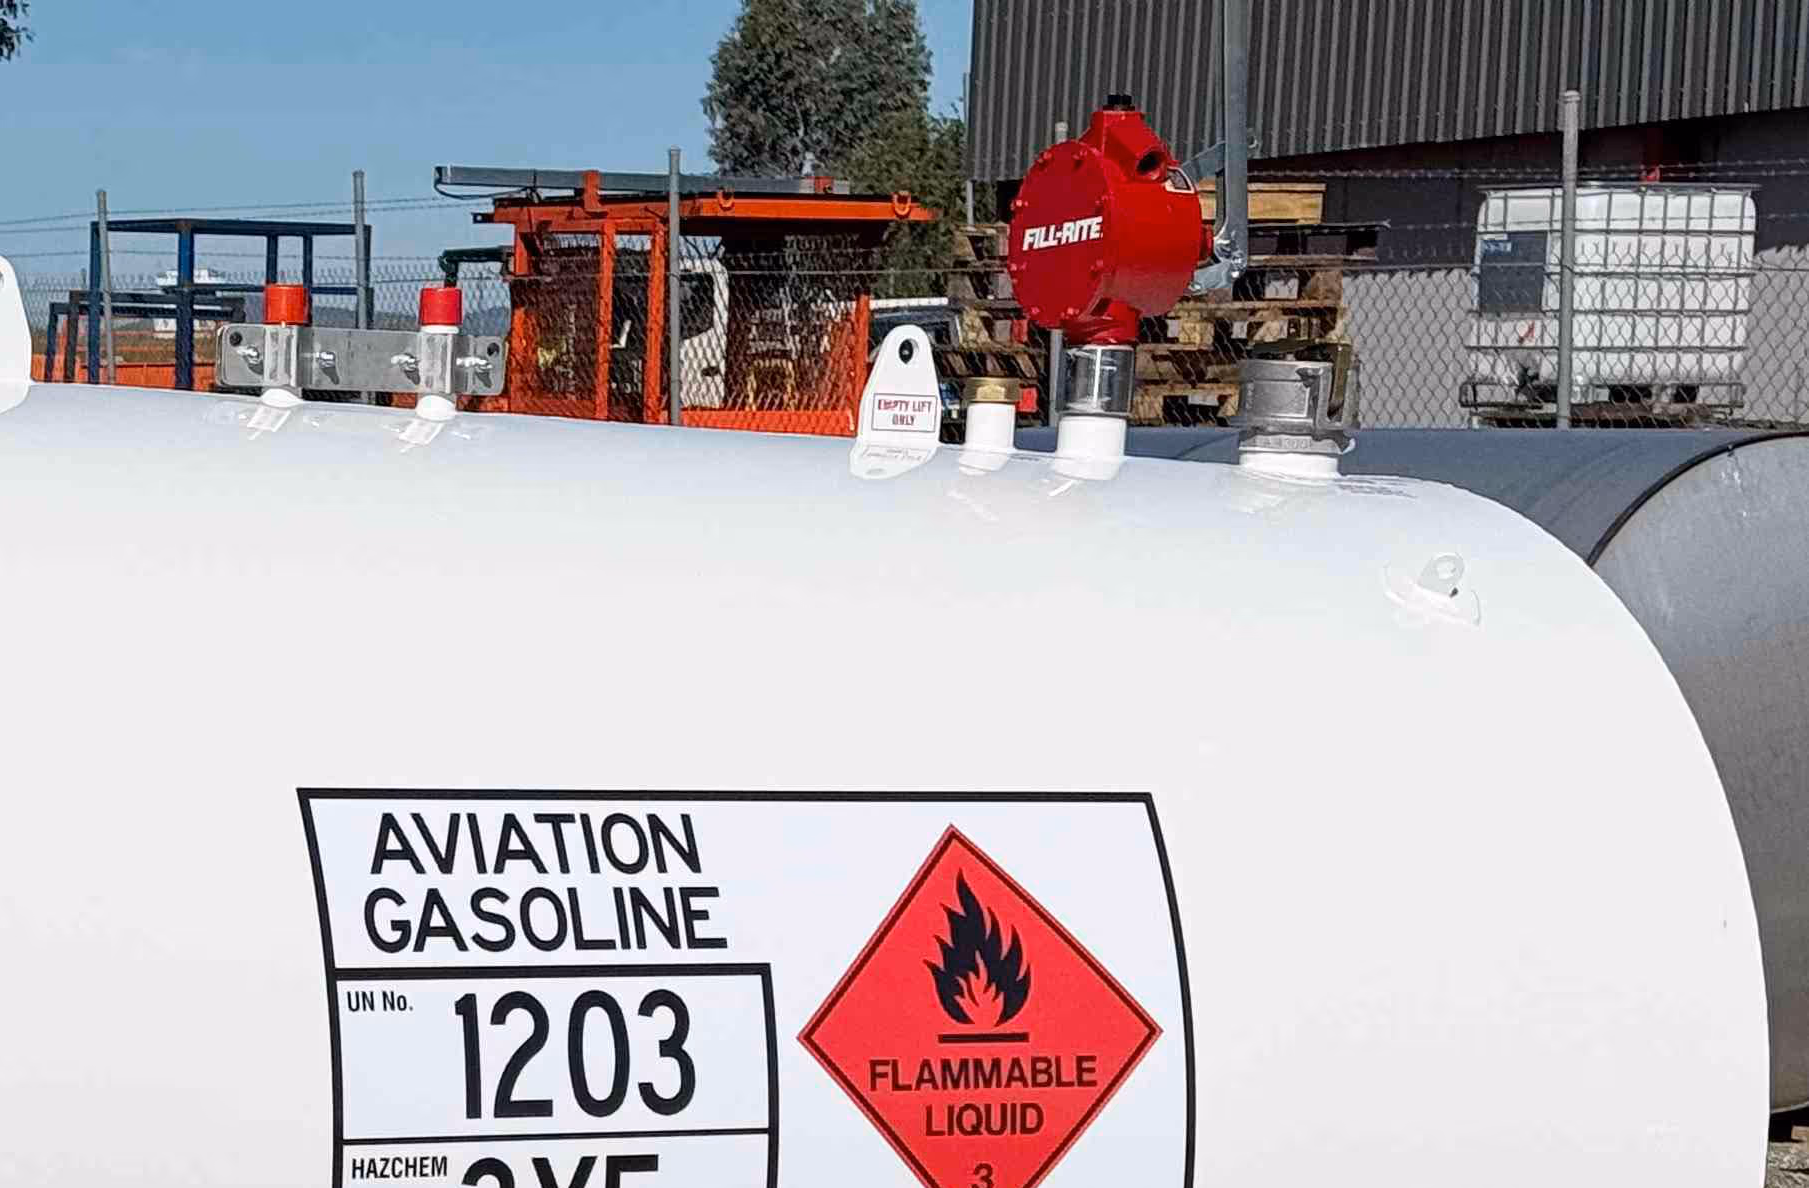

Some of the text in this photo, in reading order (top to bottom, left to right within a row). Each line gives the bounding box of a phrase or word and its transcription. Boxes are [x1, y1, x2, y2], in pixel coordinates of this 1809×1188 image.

[1022, 216, 1103, 251] FILL-RITE
[912, 401, 932, 413] LIFT
[370, 812, 702, 875] AVIATION
[363, 886, 728, 954] GASOLINE
[347, 991, 413, 1012] UN No.
[454, 988, 696, 1120] 1203
[870, 1055, 1097, 1091] FLAMMABLE
[926, 1103, 1044, 1137] LIQUID
[351, 1155, 448, 1180] HAZCHEM
